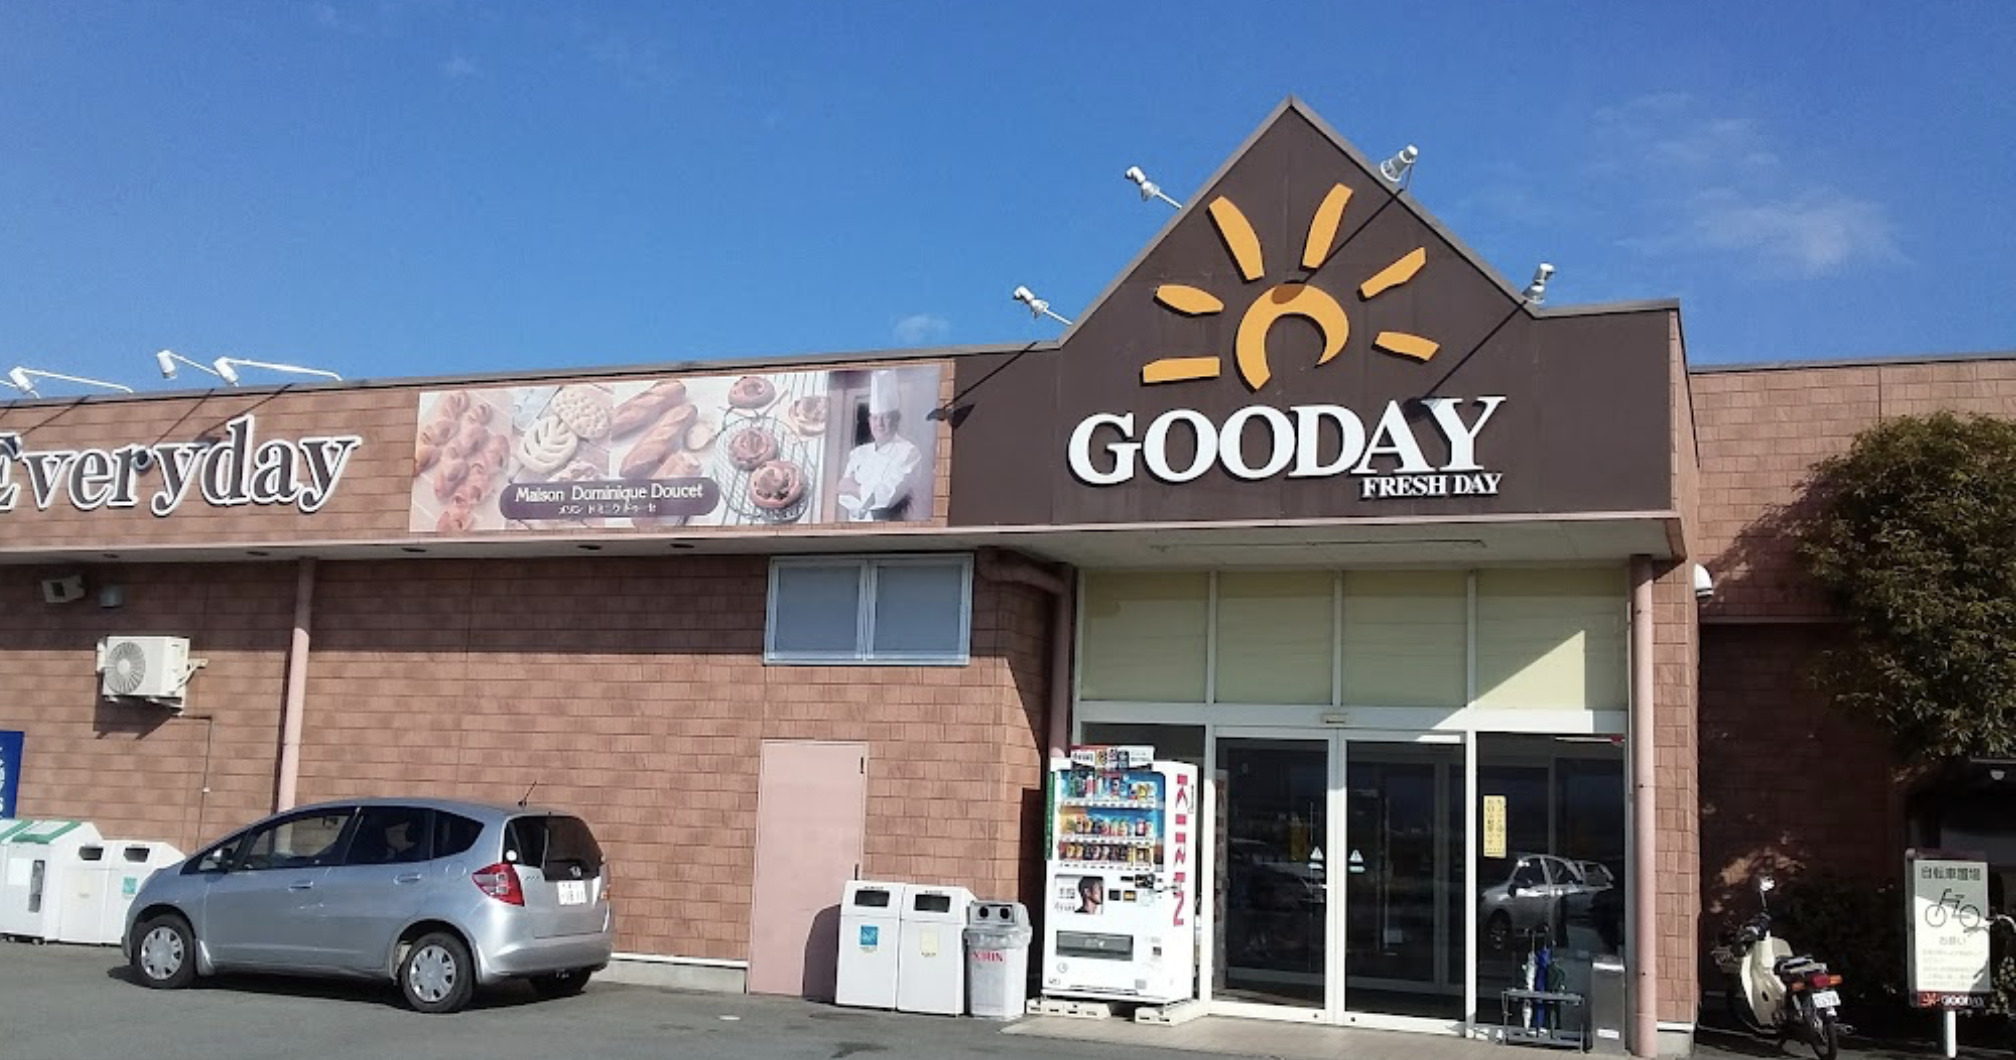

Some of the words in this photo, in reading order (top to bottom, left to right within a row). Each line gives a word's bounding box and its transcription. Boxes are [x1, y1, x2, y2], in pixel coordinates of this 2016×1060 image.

[1068, 396, 1506, 484] GOODAY
[515, 486, 564, 502] Maison
[572, 484, 647, 503] Dominique
[651, 483, 703, 498] Doucet
[1362, 475, 1448, 497] FRESH
[1453, 472, 1503, 495] DAY
[1173, 774, 1188, 926] KIRIN
